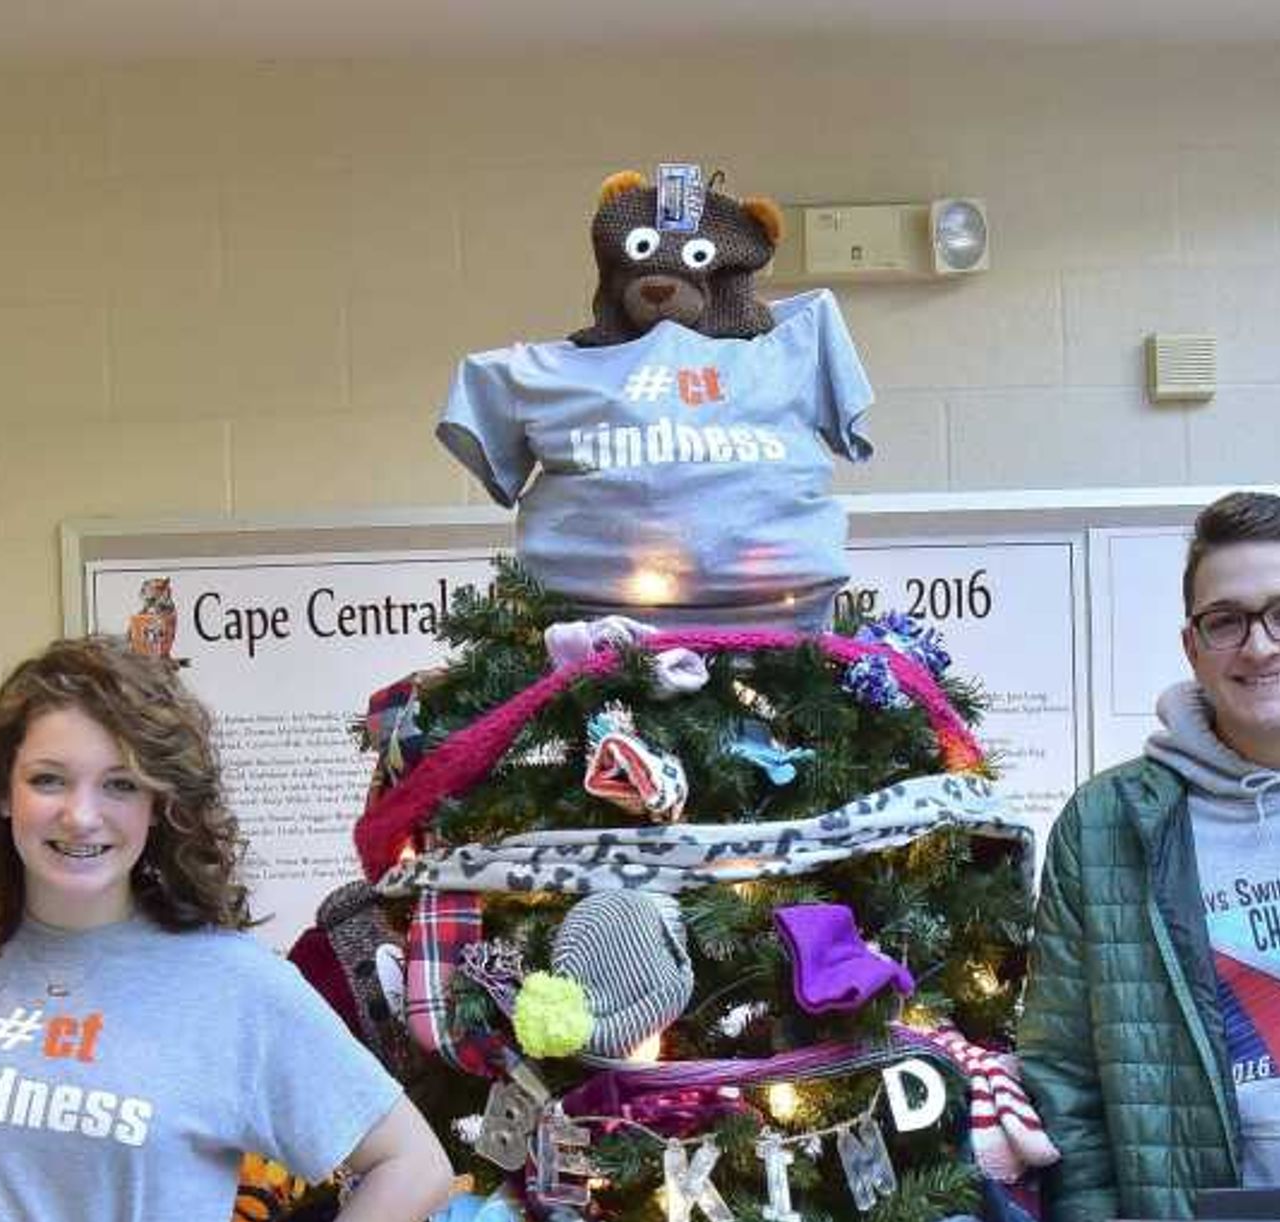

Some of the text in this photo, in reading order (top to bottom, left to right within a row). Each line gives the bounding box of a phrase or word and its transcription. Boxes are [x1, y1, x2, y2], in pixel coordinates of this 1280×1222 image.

[570, 417, 785, 469] kindness
[193, 592, 291, 658] Cape
[307, 578, 448, 638] Central
[906, 569, 993, 620] 2016
